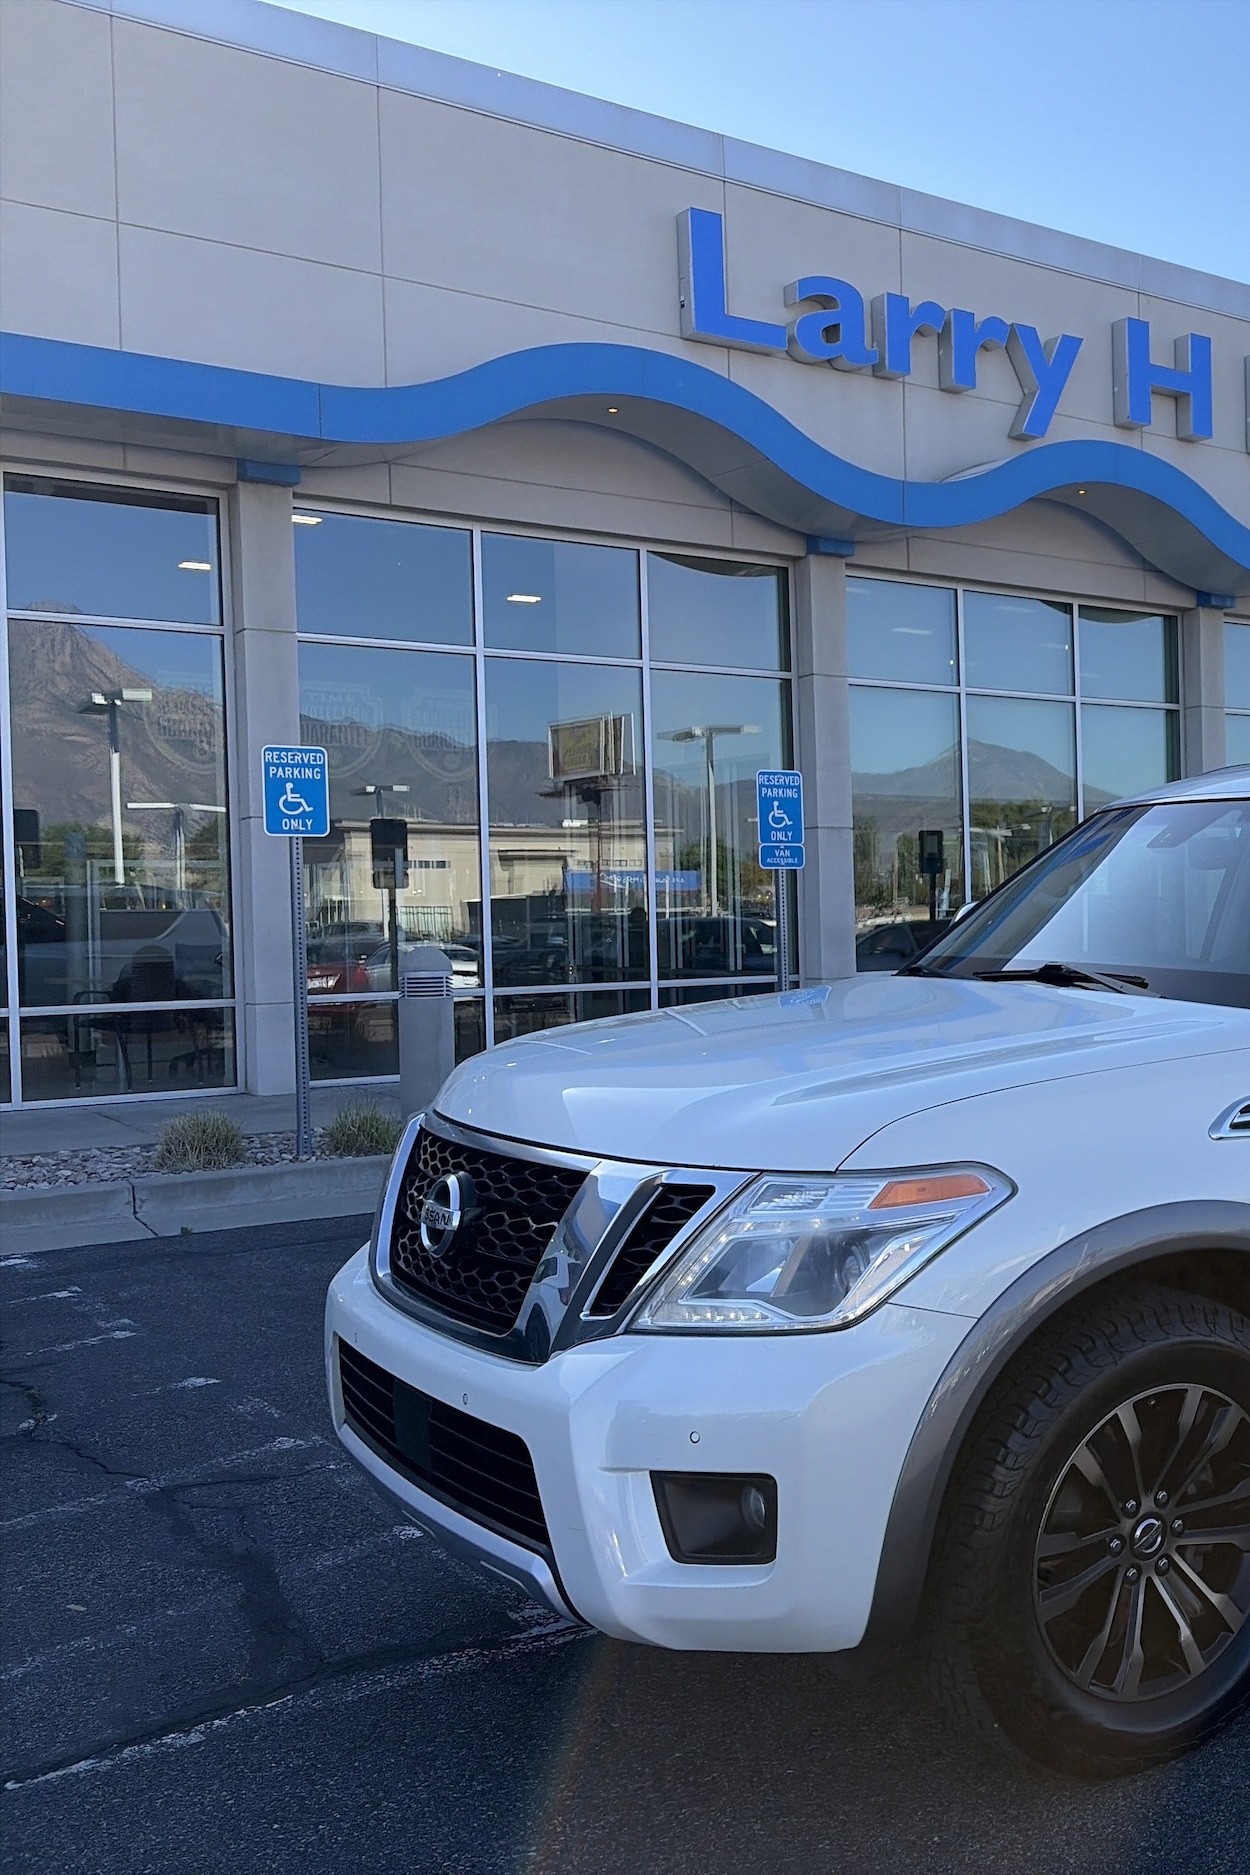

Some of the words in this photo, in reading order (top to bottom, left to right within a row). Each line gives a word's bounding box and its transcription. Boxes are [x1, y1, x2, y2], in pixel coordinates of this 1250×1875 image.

[676, 207, 1084, 440] Larry
[1113, 316, 1214, 441] H
[265, 751, 324, 765] RESERVED
[269, 766, 321, 780] PARKING
[758, 775, 800, 786] RESERVED
[762, 787, 798, 799] PARKING
[282, 818, 313, 831] ONLY
[771, 831, 792, 841] ONLY
[774, 849, 791, 857] VAN
